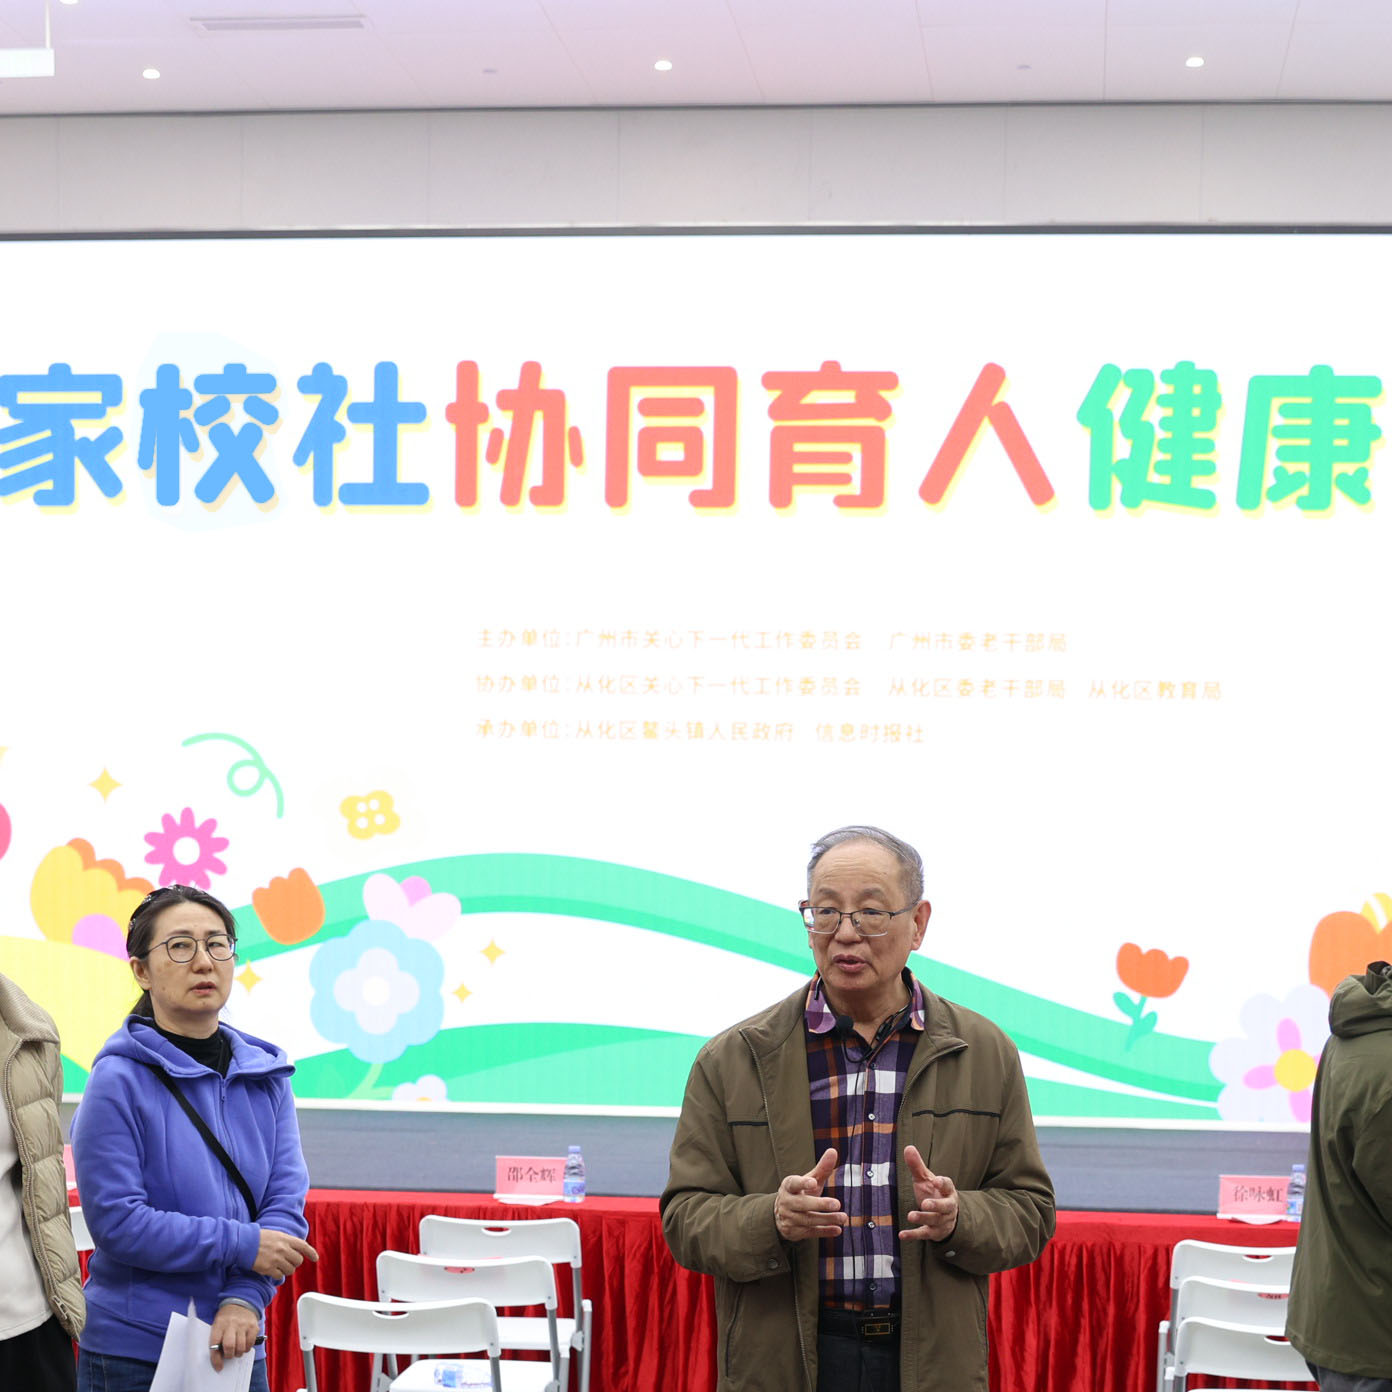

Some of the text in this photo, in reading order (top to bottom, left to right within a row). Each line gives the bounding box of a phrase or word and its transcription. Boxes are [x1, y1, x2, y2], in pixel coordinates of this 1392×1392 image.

[889, 630, 1068, 653] 广州市委老干部局
[888, 677, 1066, 700] 从化区委老干部局
[1088, 679, 1222, 701] 从化区教育局
